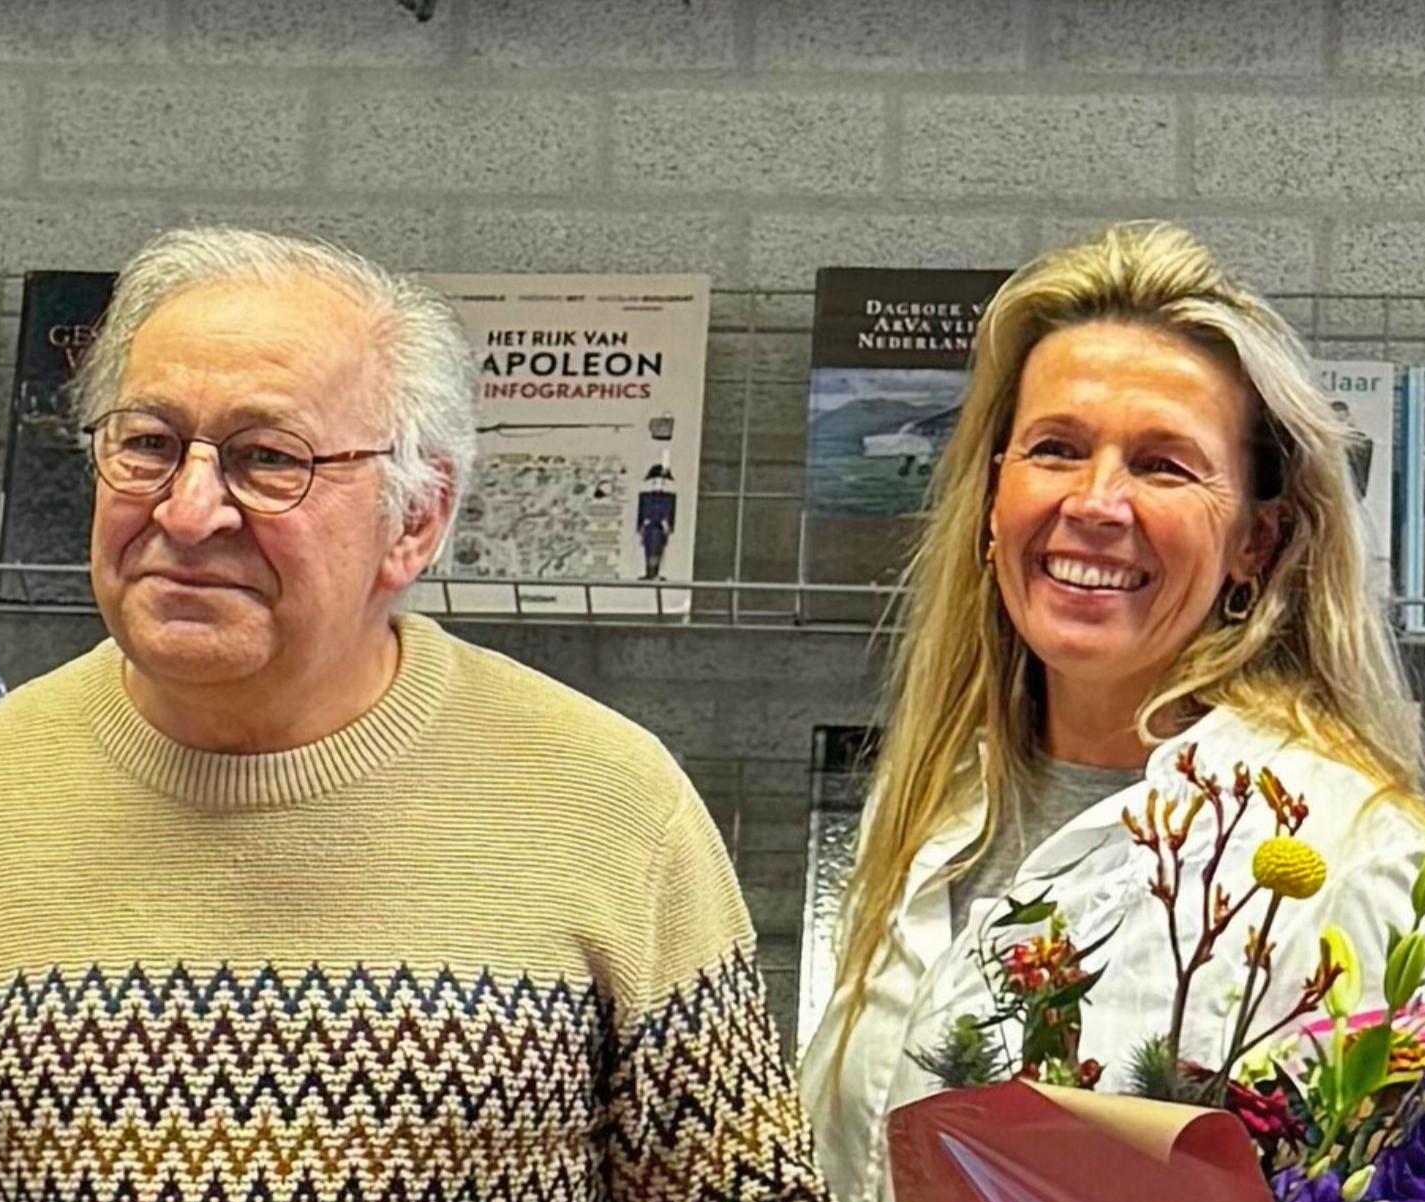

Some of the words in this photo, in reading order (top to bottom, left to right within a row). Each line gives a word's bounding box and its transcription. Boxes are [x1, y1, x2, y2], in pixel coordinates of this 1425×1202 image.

[487, 331, 526, 346] HET
[531, 331, 576, 347] RIJK
[583, 331, 629, 347] VAN
[857, 332, 976, 351] NEDERLAN
[479, 352, 663, 376] APOLEON
[484, 383, 652, 399] INFOGRAPHICS
[1322, 370, 1383, 393] laar
